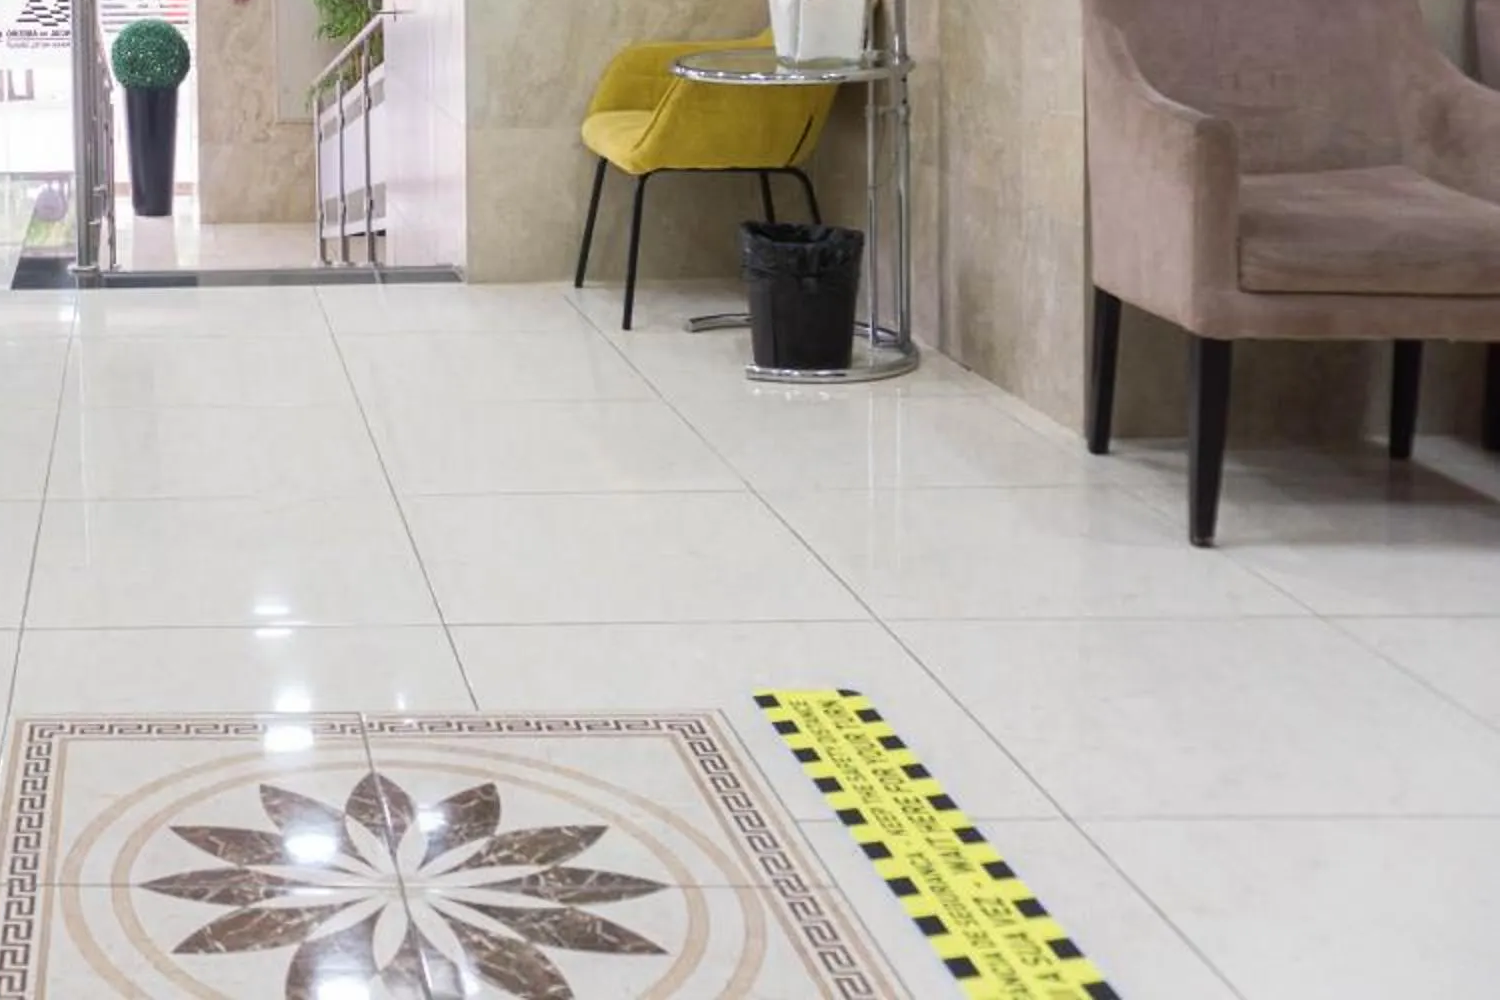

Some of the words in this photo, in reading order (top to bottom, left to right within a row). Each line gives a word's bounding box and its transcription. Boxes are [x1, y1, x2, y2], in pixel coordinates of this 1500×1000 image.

[813, 700, 863, 730] TURN
[839, 732, 891, 765] YOUR
[868, 769, 914, 793] FOR
[890, 796, 946, 833] HERE
[923, 837, 980, 874] WAIT
